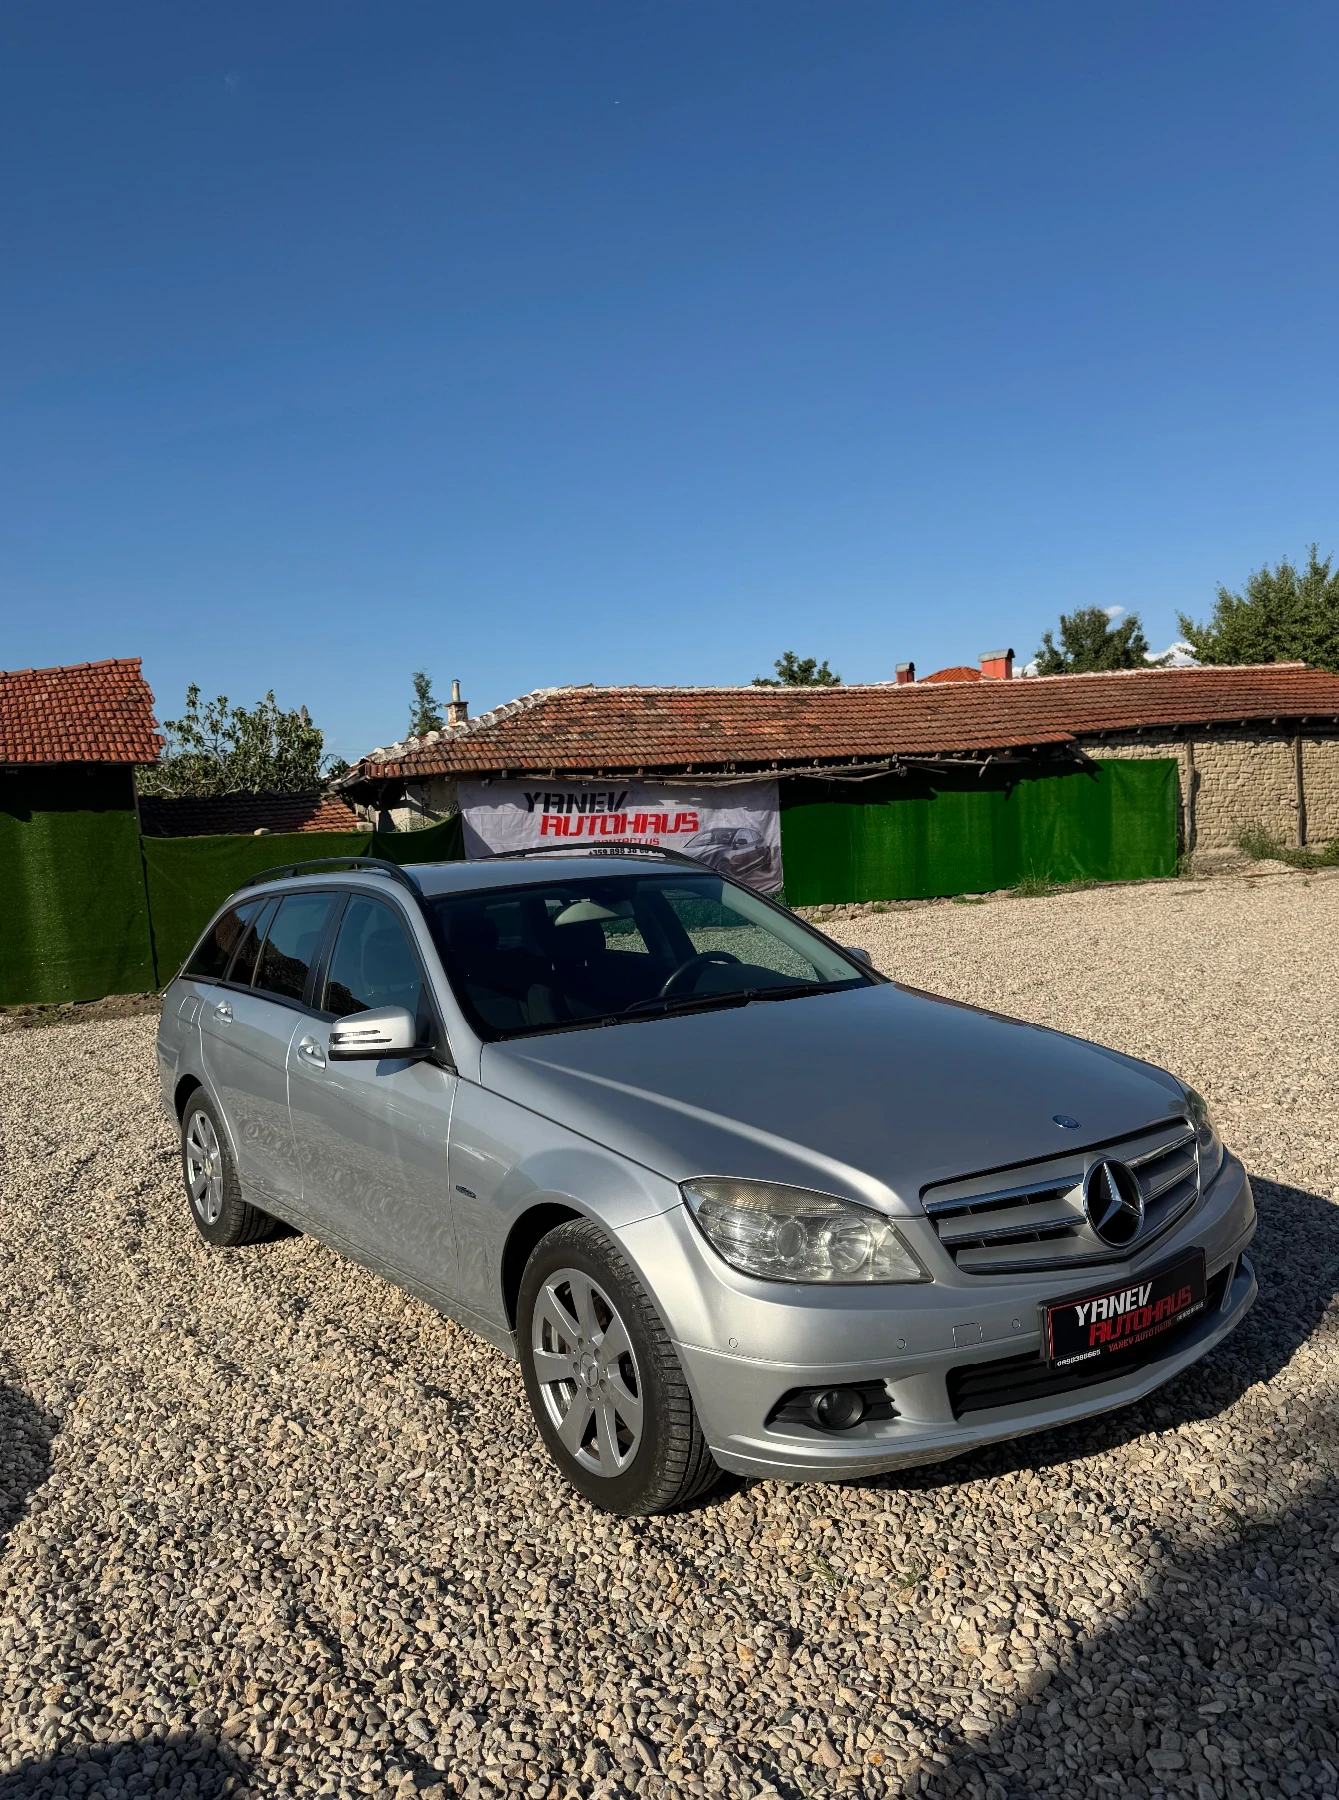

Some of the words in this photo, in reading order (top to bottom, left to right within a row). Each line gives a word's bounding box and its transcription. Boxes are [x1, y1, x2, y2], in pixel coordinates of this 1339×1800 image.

[523, 790, 629, 814] YANEV
[540, 811, 699, 837] AUTOHAUS
[645, 837, 660, 846] US
[1074, 1281, 1153, 1327] YANEV
[1089, 1284, 1192, 1346] AUTOHAUS
[1108, 1335, 1134, 1352] YANEV
